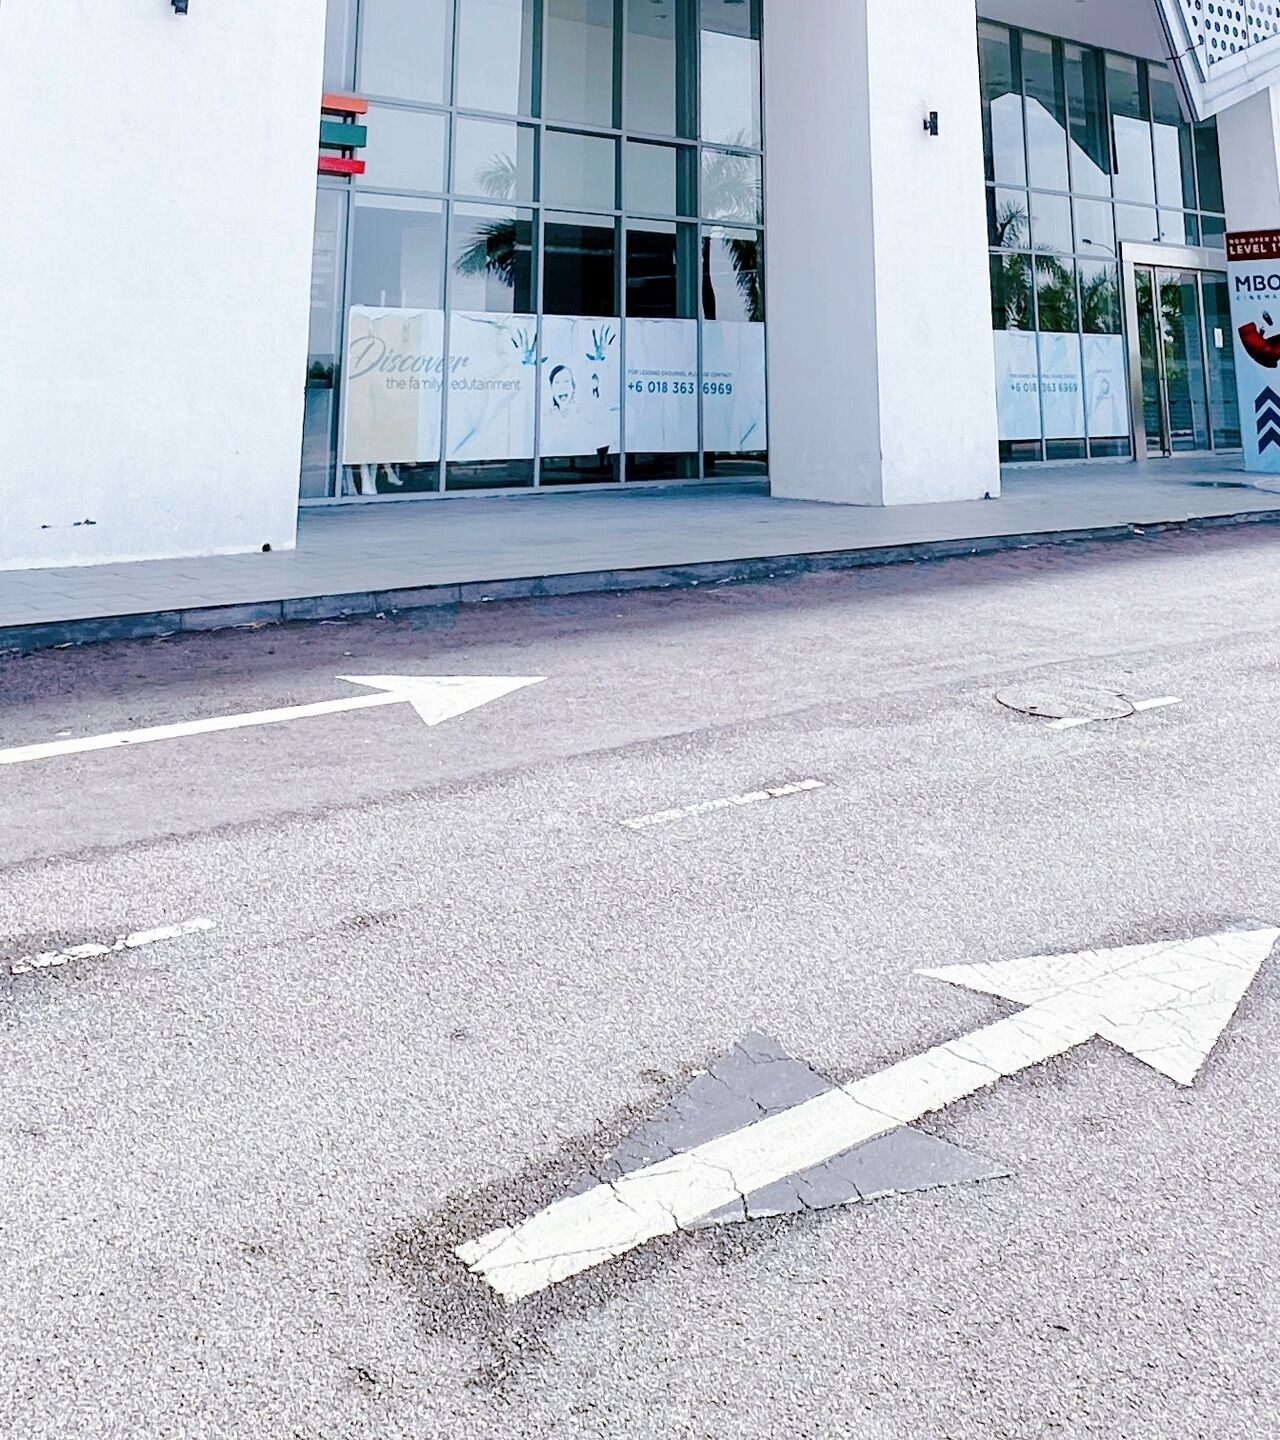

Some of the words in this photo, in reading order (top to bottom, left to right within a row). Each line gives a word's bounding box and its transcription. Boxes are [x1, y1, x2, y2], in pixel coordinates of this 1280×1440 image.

[1229, 243, 1267, 255] LEVEL
[349, 335, 470, 380] Discover
[386, 377, 406, 390] the
[408, 376, 442, 393] family
[451, 376, 521, 391] edutainment
[628, 381, 642, 393] +6
[647, 381, 668, 393] 018
[672, 382, 694, 394] 363
[702, 382, 733, 395] 6969
